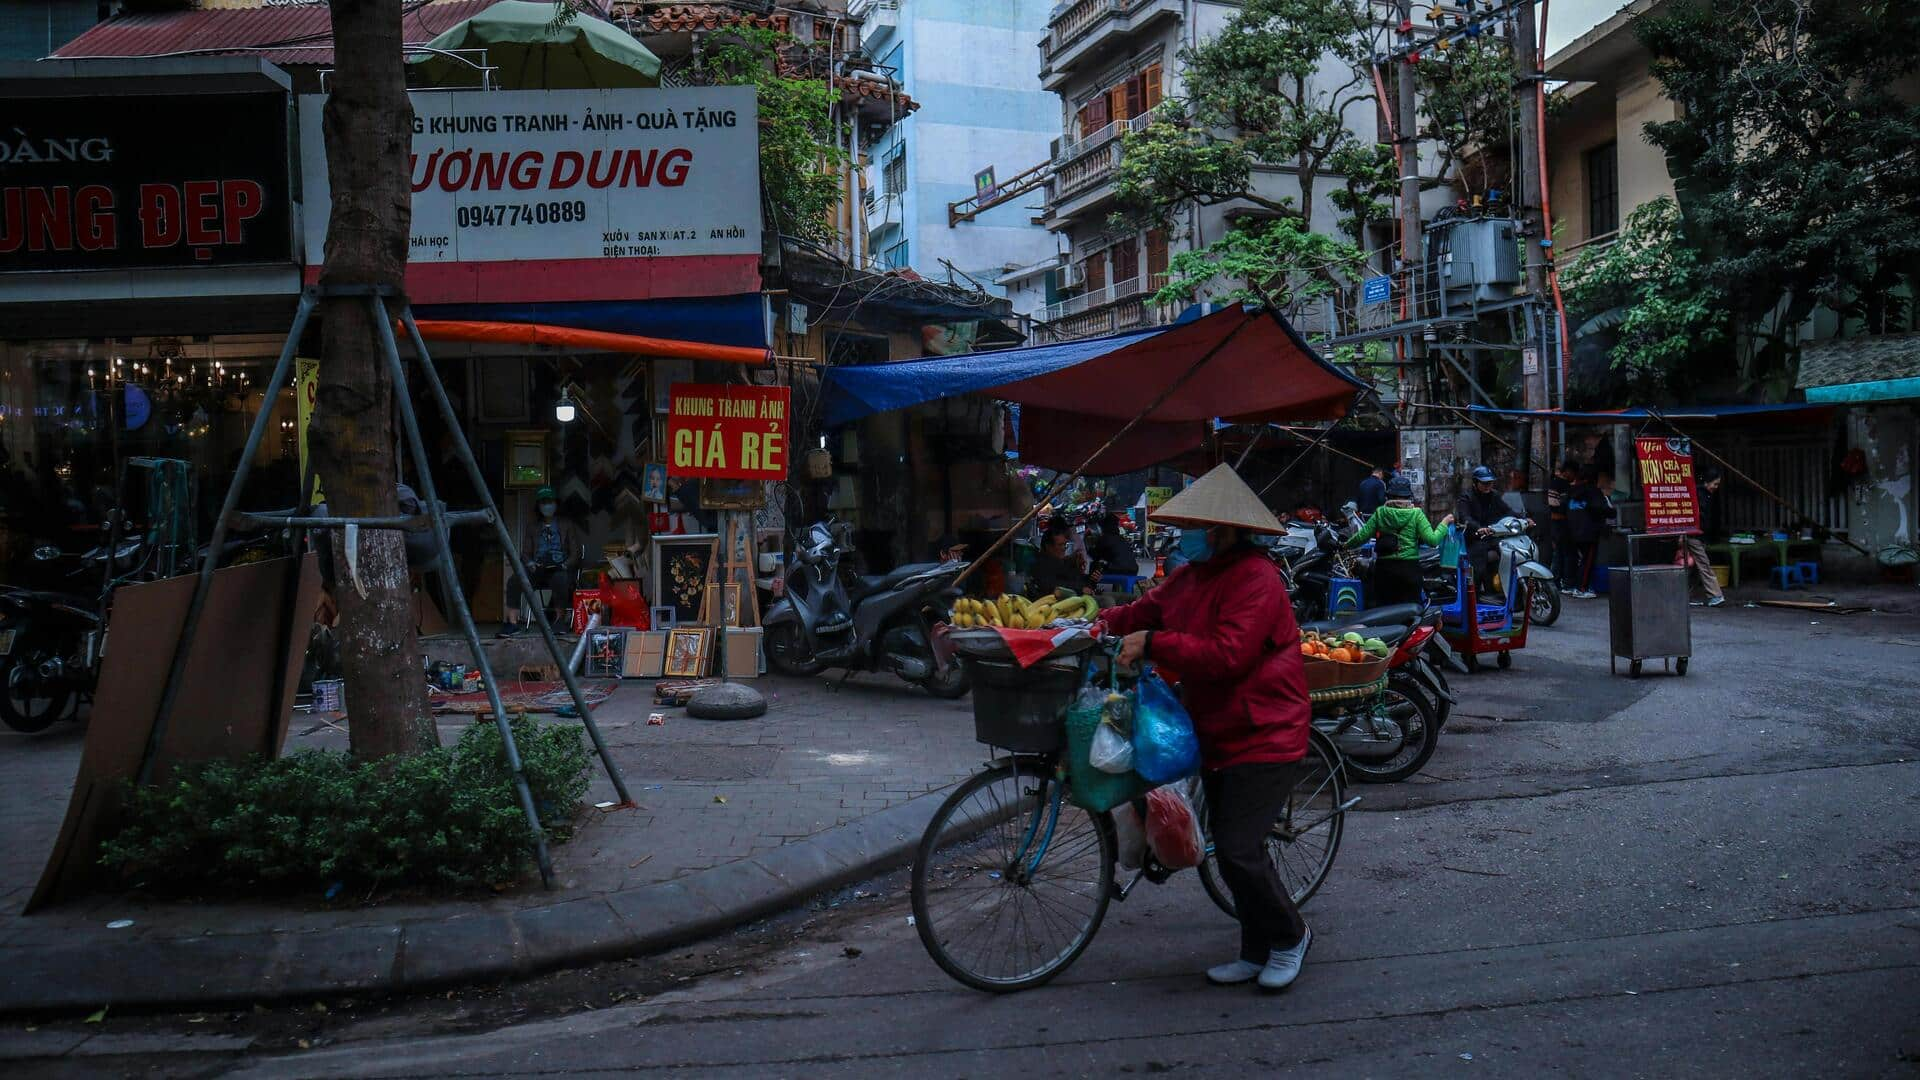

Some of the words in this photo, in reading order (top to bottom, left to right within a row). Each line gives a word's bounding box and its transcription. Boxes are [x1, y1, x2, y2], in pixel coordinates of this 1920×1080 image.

[430, 115, 497, 134] KHUNG
[502, 114, 568, 132] TRANH
[582, 107, 623, 130] ẢNH
[636, 108, 679, 130] QUÀ
[682, 106, 737, 133] TẶNG
[408, 147, 545, 193] ƯƠNG
[548, 148, 693, 190] DUNG
[138, 179, 264, 261] ĐẸP
[457, 200, 586, 228] 0947740889
[408, 235, 427, 247] HÁI
[429, 236, 449, 248] HỌC
[675, 397, 714, 417] KHUNG
[718, 398, 756, 418] TRANH
[760, 394, 785, 419] ẢNH
[674, 423, 726, 469] GIÁ
[741, 422, 783, 471] RẺ
